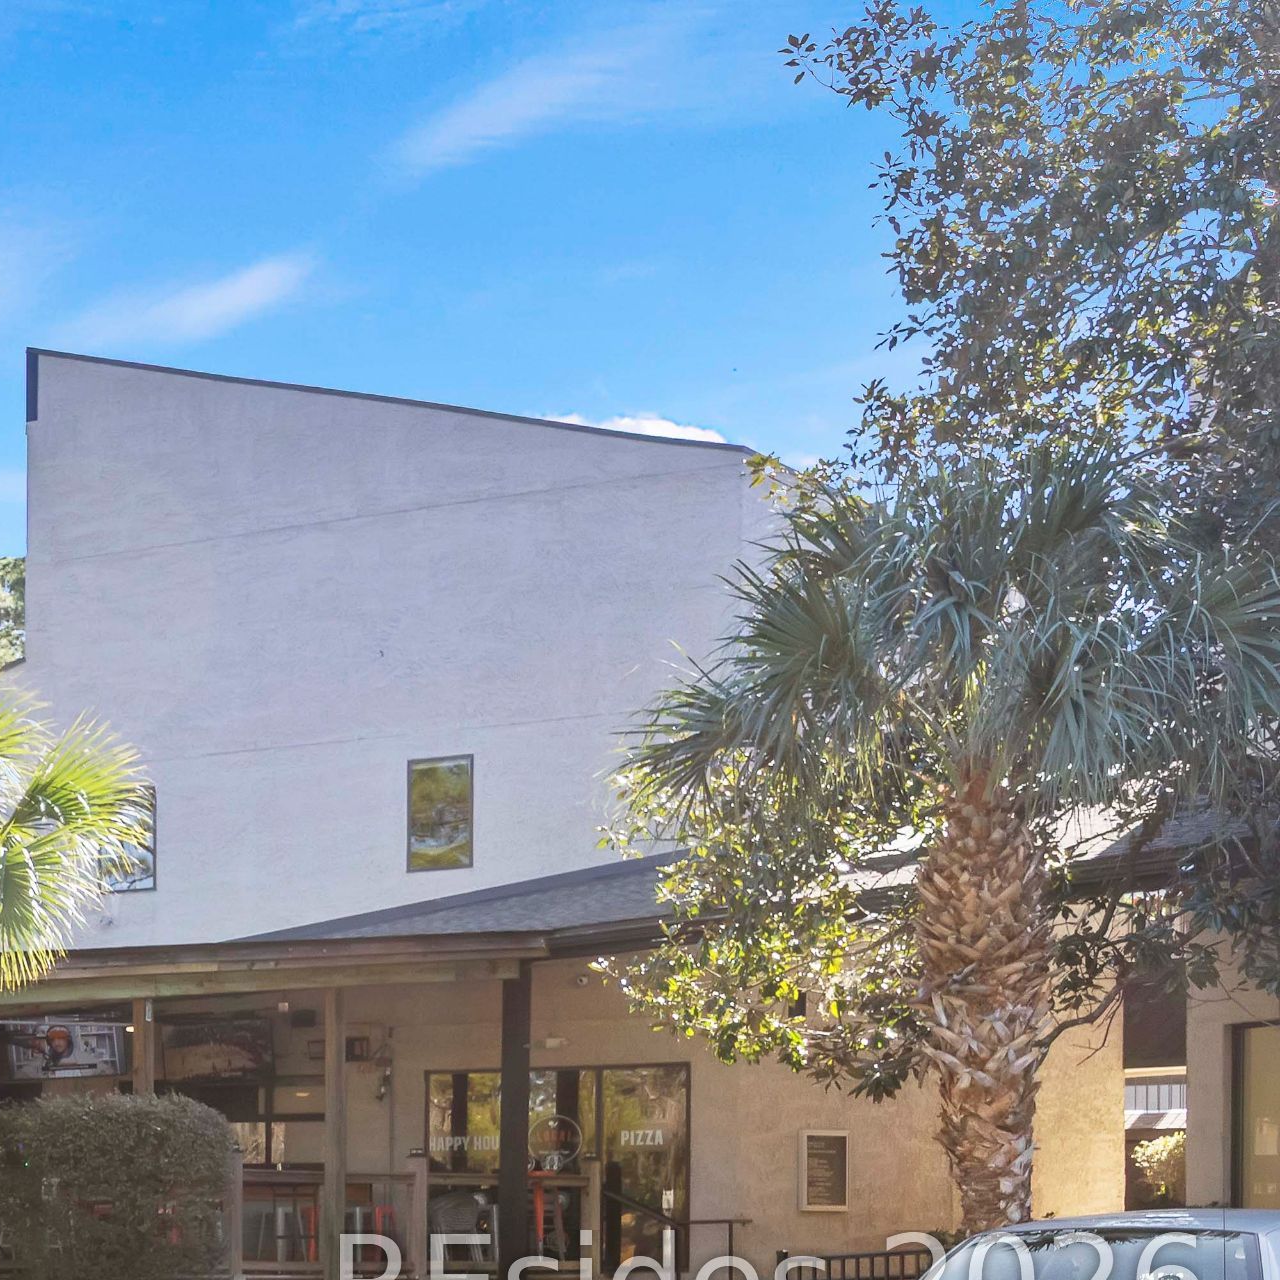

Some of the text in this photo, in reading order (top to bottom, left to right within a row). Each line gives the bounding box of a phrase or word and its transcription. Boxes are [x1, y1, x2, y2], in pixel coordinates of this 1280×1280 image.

[429, 1136, 501, 1151] HAPPY HOU
[621, 1130, 663, 1146] PIZZA
